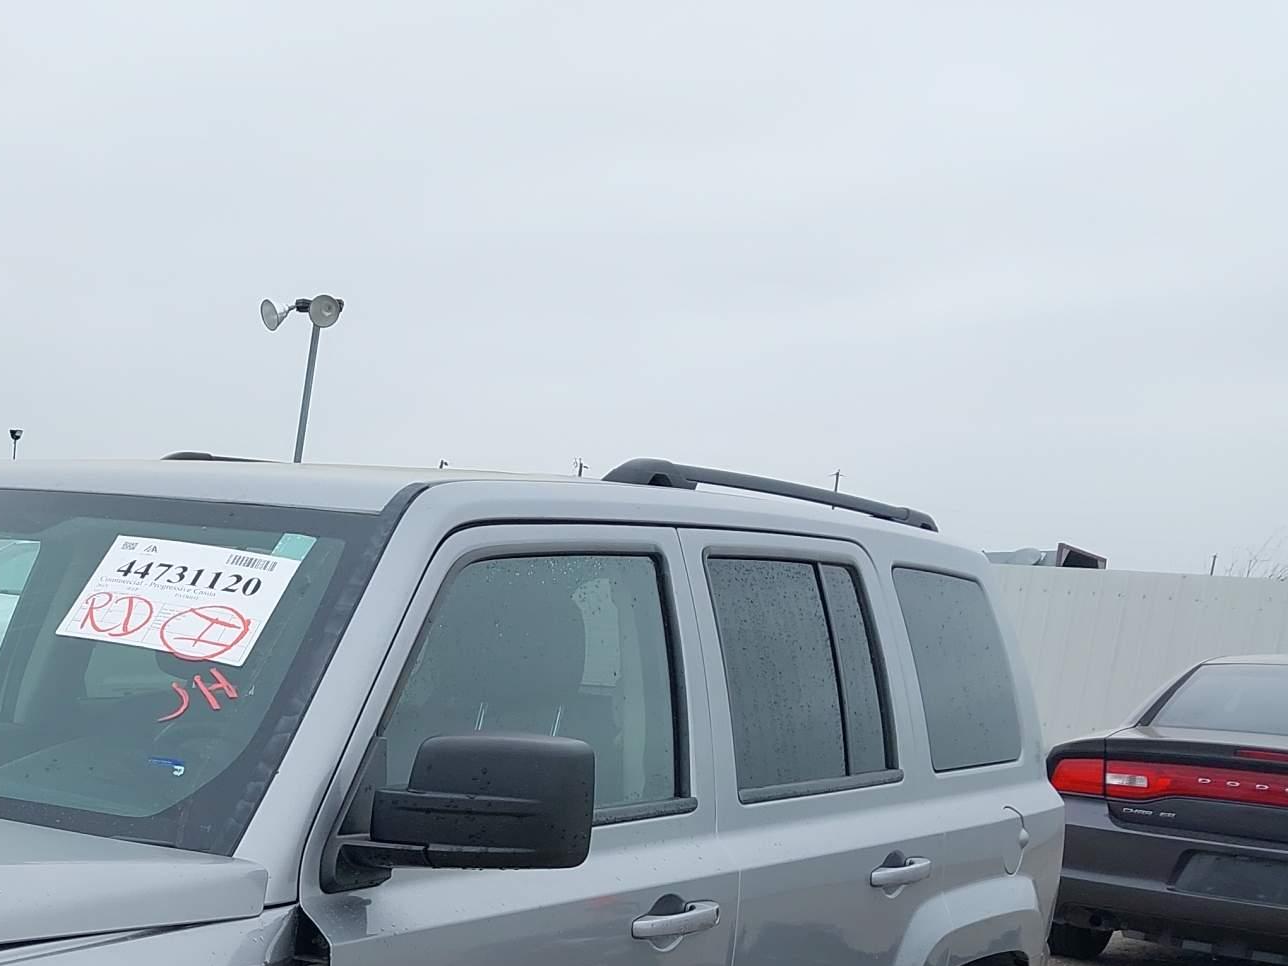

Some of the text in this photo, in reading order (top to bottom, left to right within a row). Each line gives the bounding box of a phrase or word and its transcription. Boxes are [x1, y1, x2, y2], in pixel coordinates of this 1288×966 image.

[116, 559, 262, 597] 44731120
[79, 591, 154, 637] RD
[1198, 777, 1288, 793] DOD
